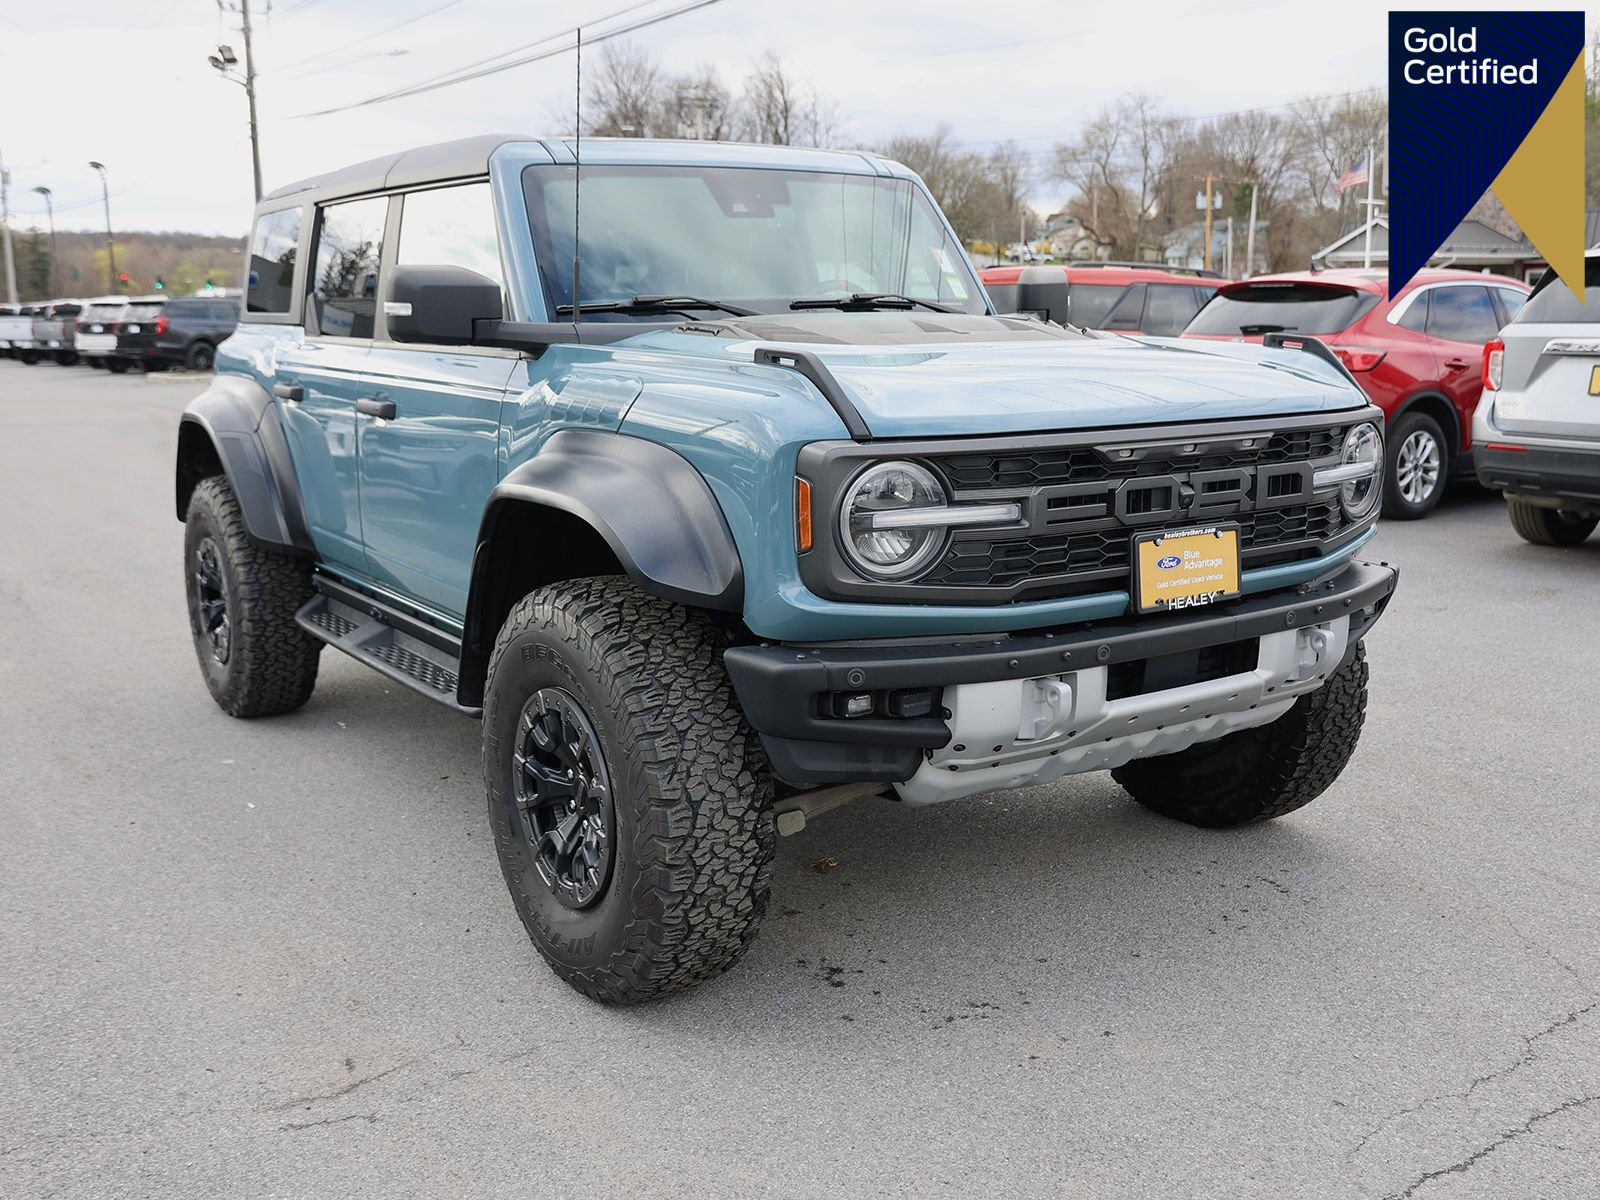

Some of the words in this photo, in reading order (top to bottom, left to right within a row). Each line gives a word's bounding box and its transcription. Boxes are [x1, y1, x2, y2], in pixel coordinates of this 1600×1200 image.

[1031, 461, 1314, 533] FORD
[1164, 528, 1216, 539] healeybrothers.com
[1183, 549, 1200, 560] Blue
[1183, 558, 1224, 571] Advantage
[1156, 581, 1169, 590] Gold
[1169, 576, 1191, 588] Certified
[1191, 574, 1205, 584] Used
[1205, 572, 1224, 582] Vehicle
[1168, 592, 1216, 610] HEALEY
